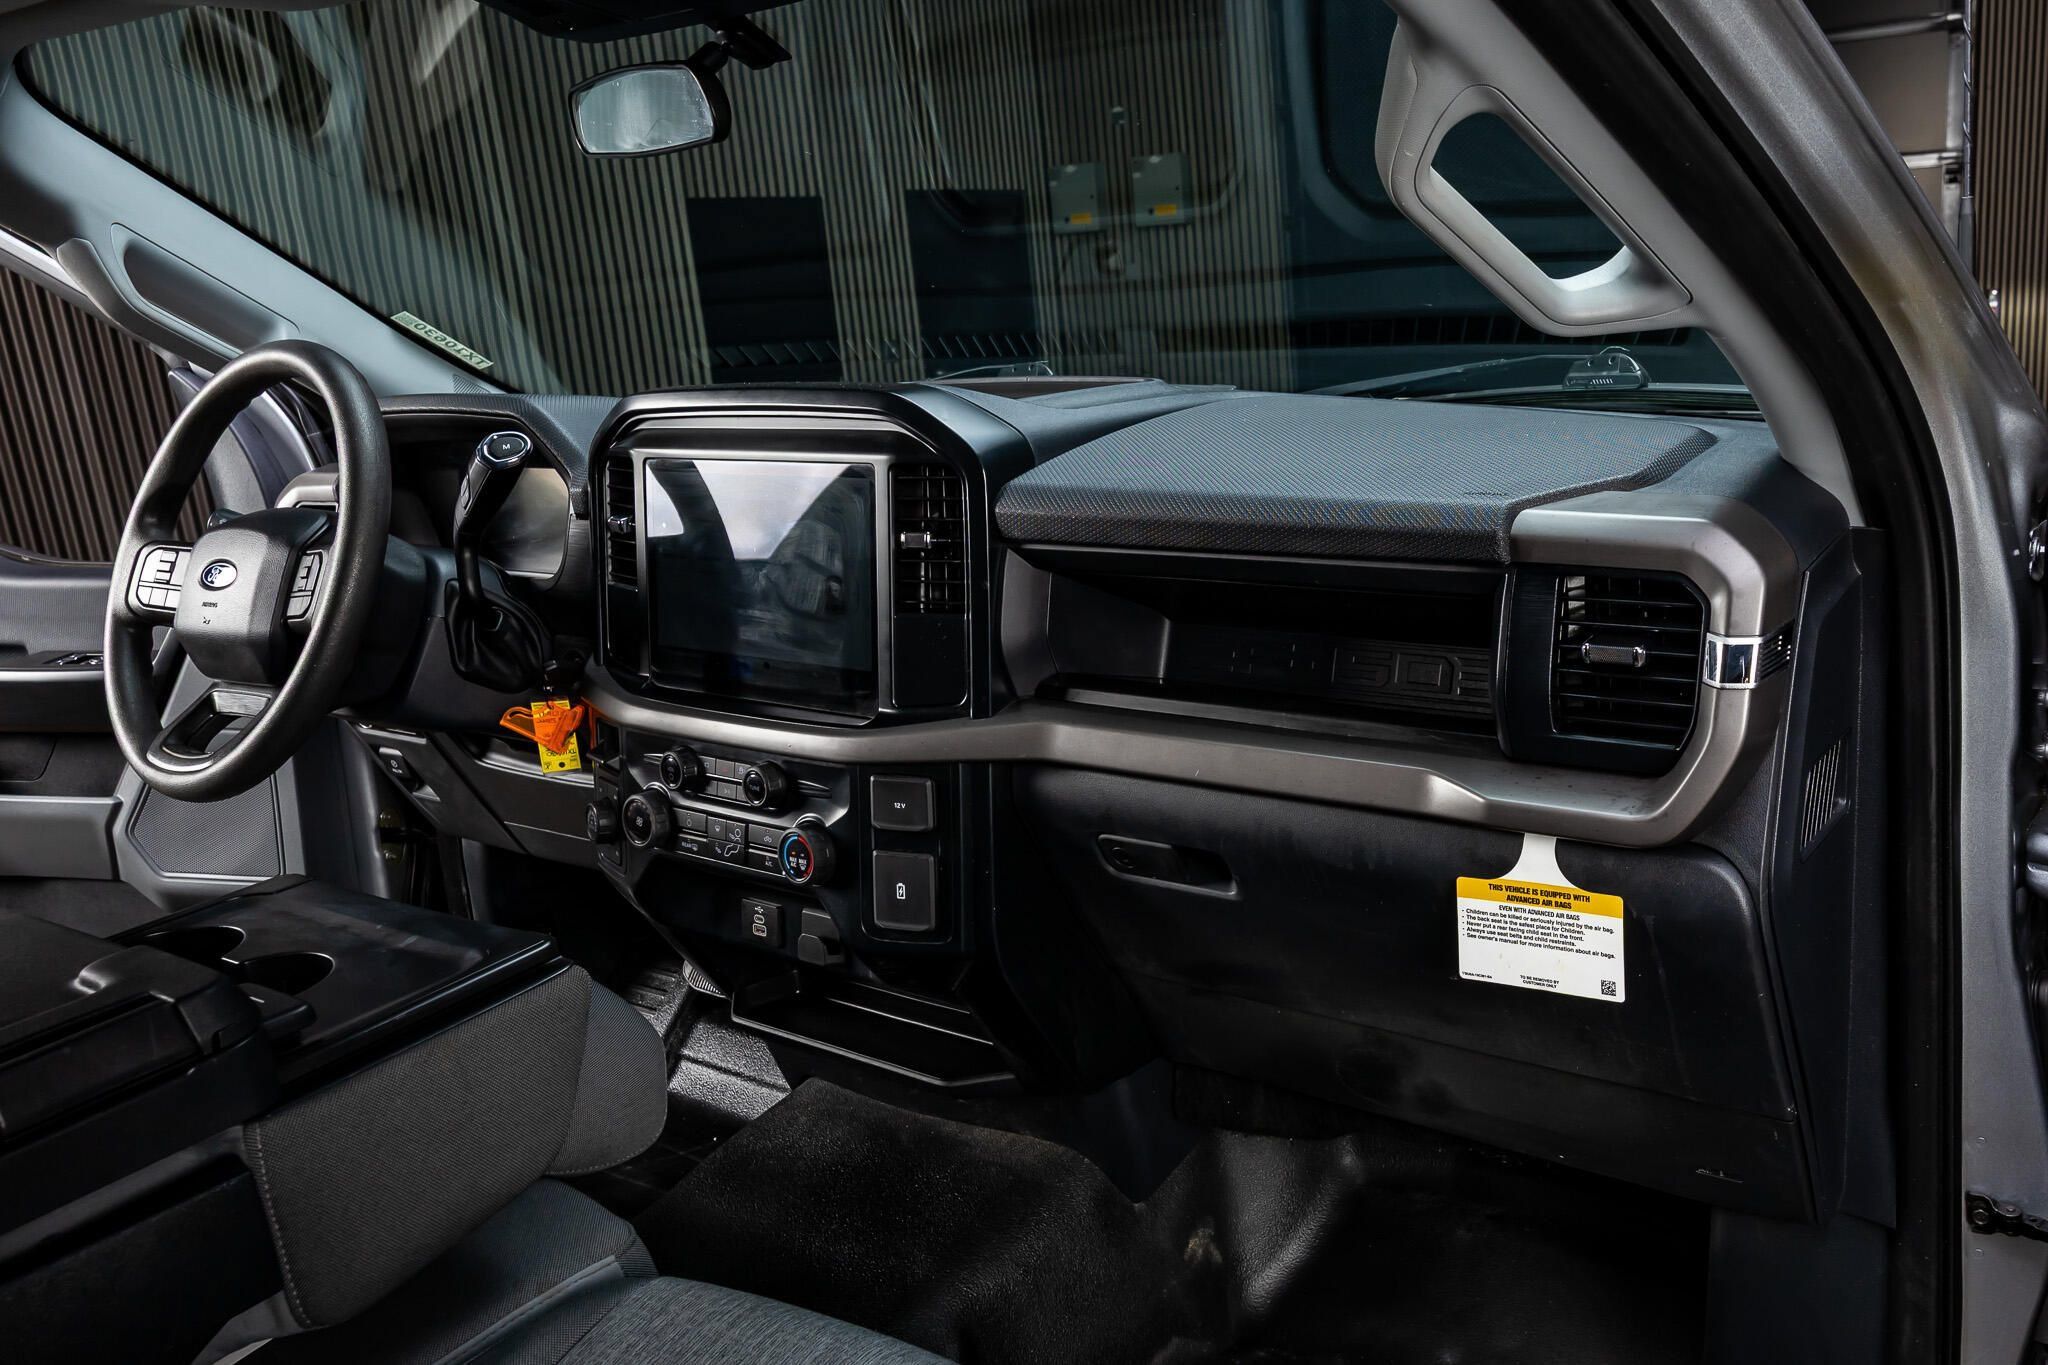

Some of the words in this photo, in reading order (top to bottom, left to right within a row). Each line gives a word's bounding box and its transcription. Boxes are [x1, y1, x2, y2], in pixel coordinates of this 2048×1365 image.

[1488, 883, 1503, 891] THIS
[1504, 885, 1530, 894] VEHICLE
[1540, 889, 1571, 900] EQUIPPED
[1573, 894, 1590, 902] WITH
[1506, 895, 1540, 905] ADVANCED
[1554, 901, 1571, 909] BAGS
[1466, 908, 1488, 916] Children
[1530, 917, 1554, 925] seriously
[1556, 919, 1575, 928] injured
[1513, 906, 1526, 914] WITH
[1528, 908, 1554, 917] ADVANCED
[1566, 913, 1580, 921] BAGS
[1467, 926, 1485, 934] Always
[1509, 926, 1524, 934] facing
[1536, 923, 1550, 931] place
[1543, 943, 1574, 953] information
